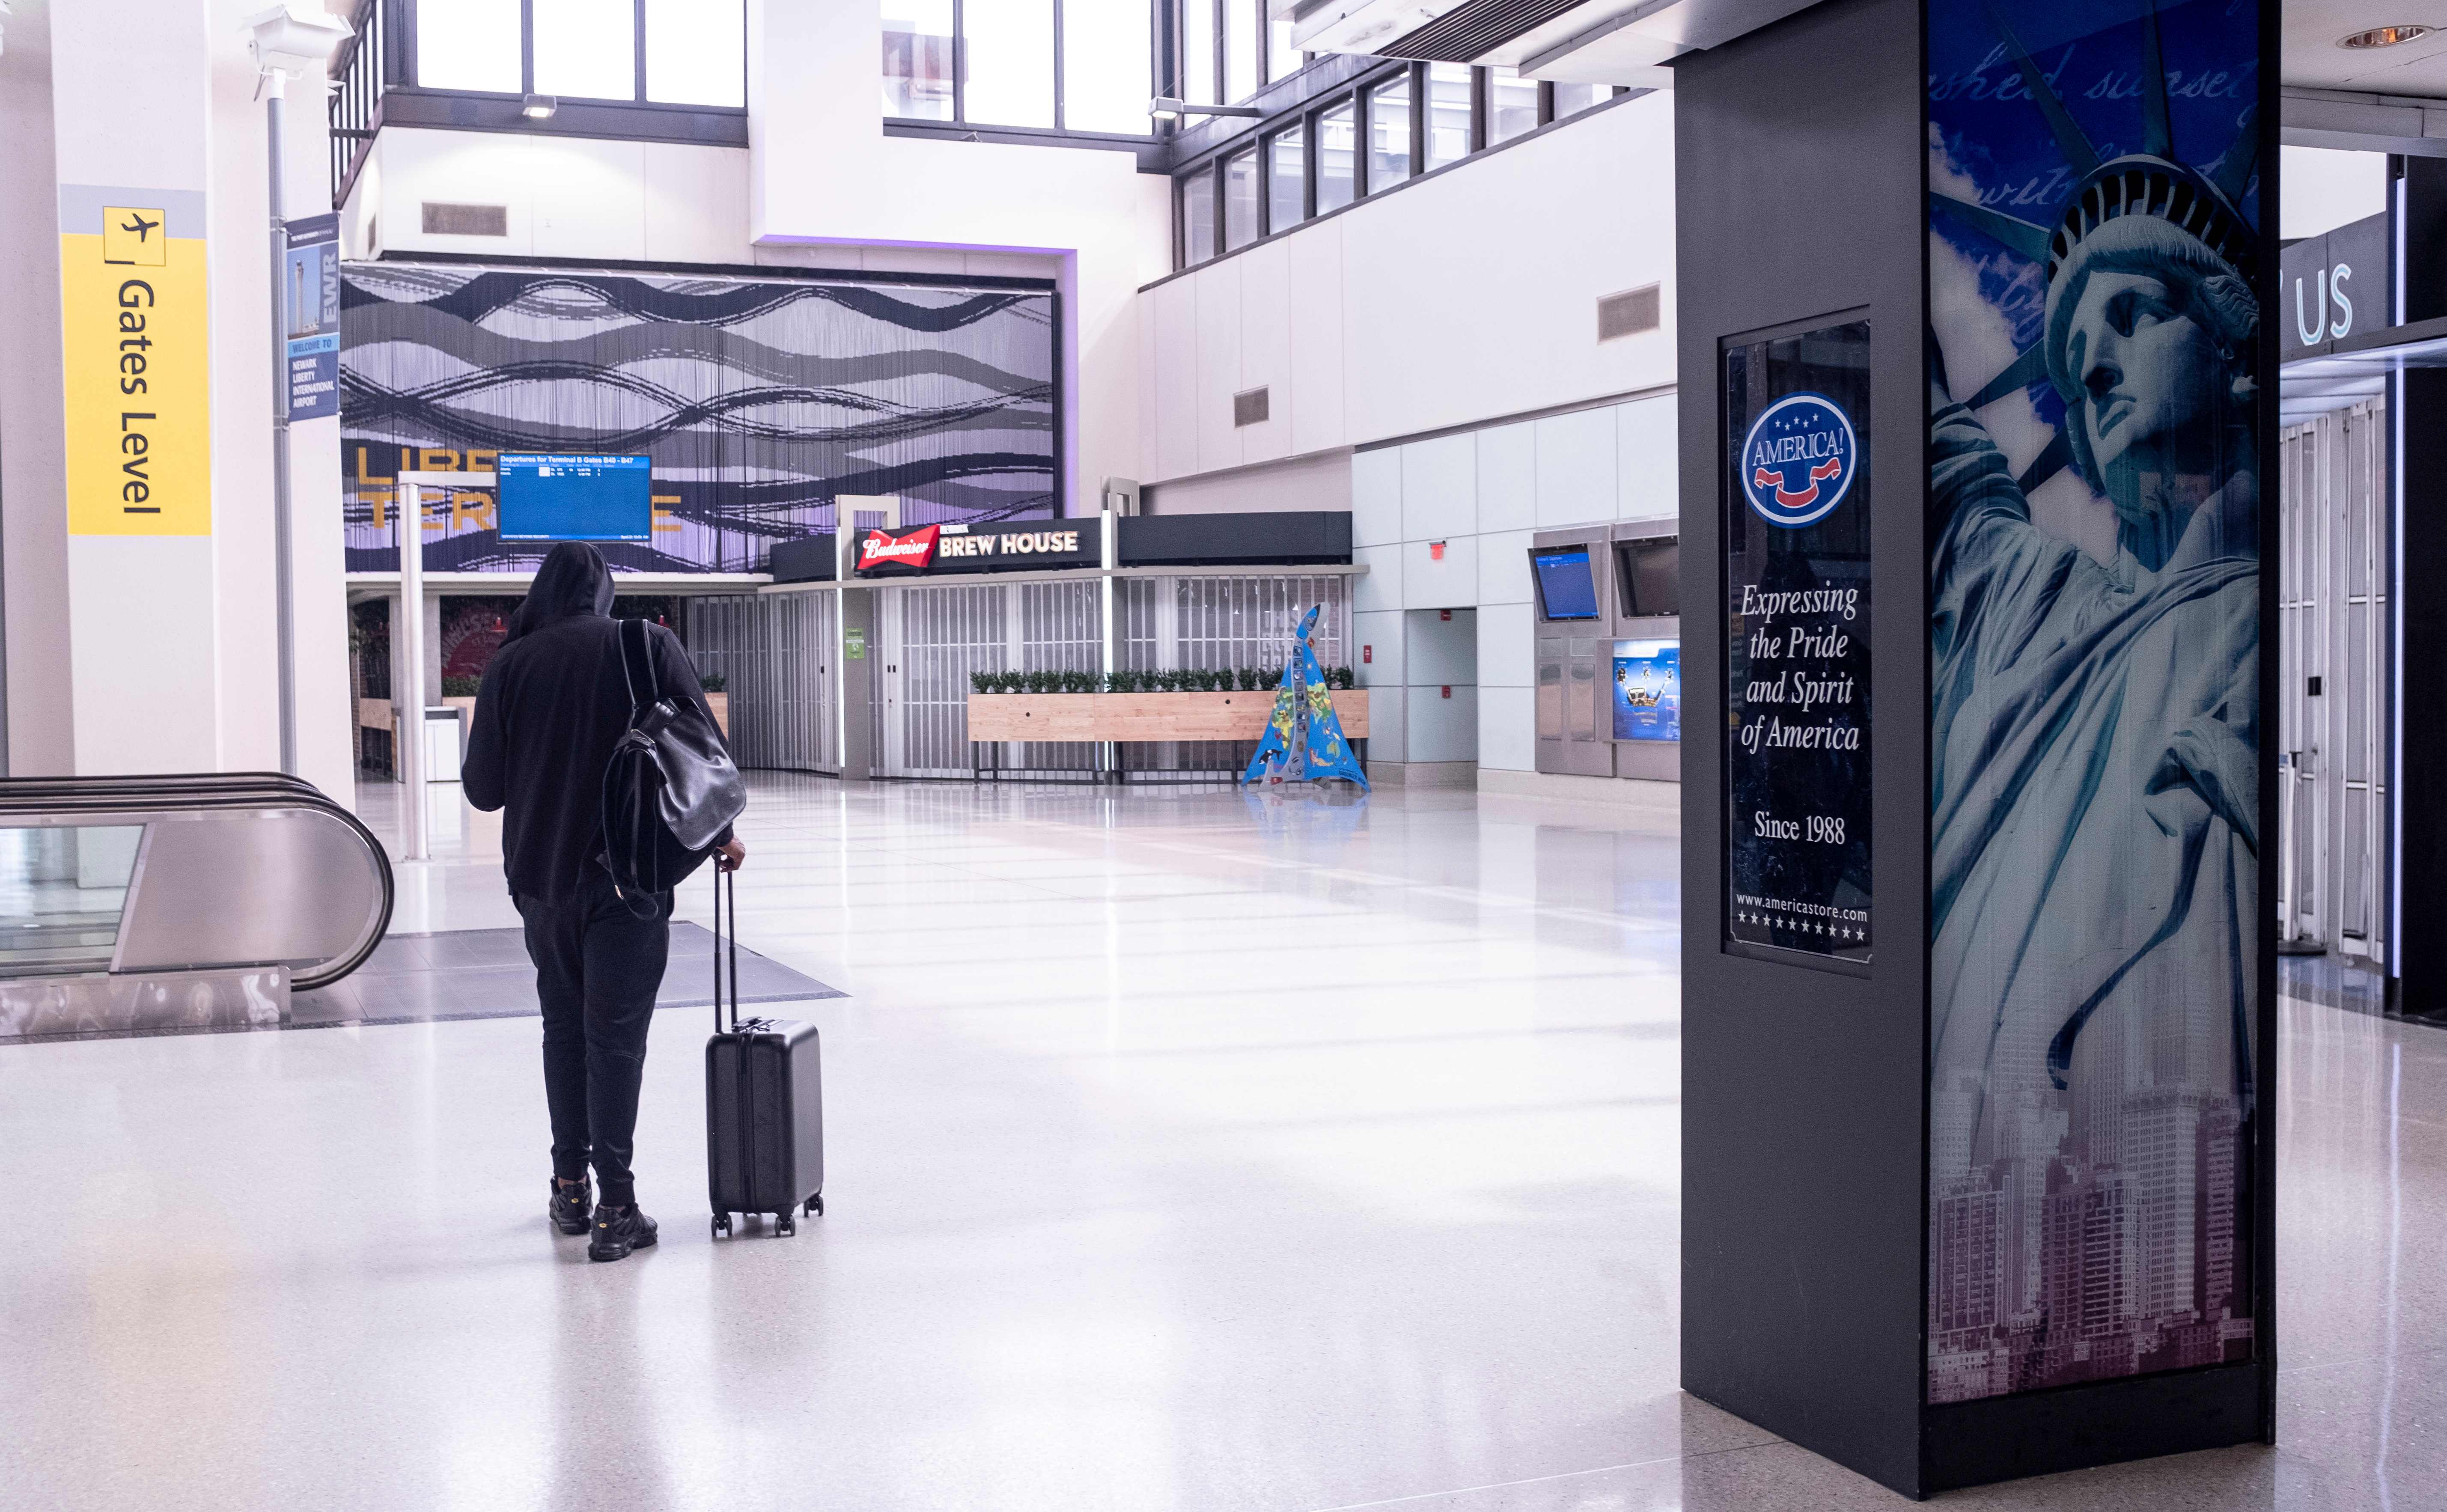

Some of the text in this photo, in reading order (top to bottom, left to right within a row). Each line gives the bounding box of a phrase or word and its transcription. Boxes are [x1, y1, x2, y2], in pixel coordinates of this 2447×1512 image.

[323, 252, 337, 323] EWR
[292, 339, 332, 353] WELCOME TO
[293, 358, 317, 371] NEWARK
[293, 371, 315, 384] LIBERTY
[119, 280, 161, 513] Gates Level
[293, 380, 335, 396] INTERNATIONAL
[293, 395, 317, 408] AIRPORT
[1753, 428, 1843, 466] AMERICA!
[863, 531, 1078, 559] Budweiser BREW HOUSE
[1740, 580, 1858, 623] Expressing
[1750, 625, 1849, 659] the Pride
[1746, 671, 1854, 712] and Spirit
[1741, 715, 1859, 754] of America
[1755, 811, 1845, 845] Since 1988
[1736, 894, 1867, 922] www.americastore.com
